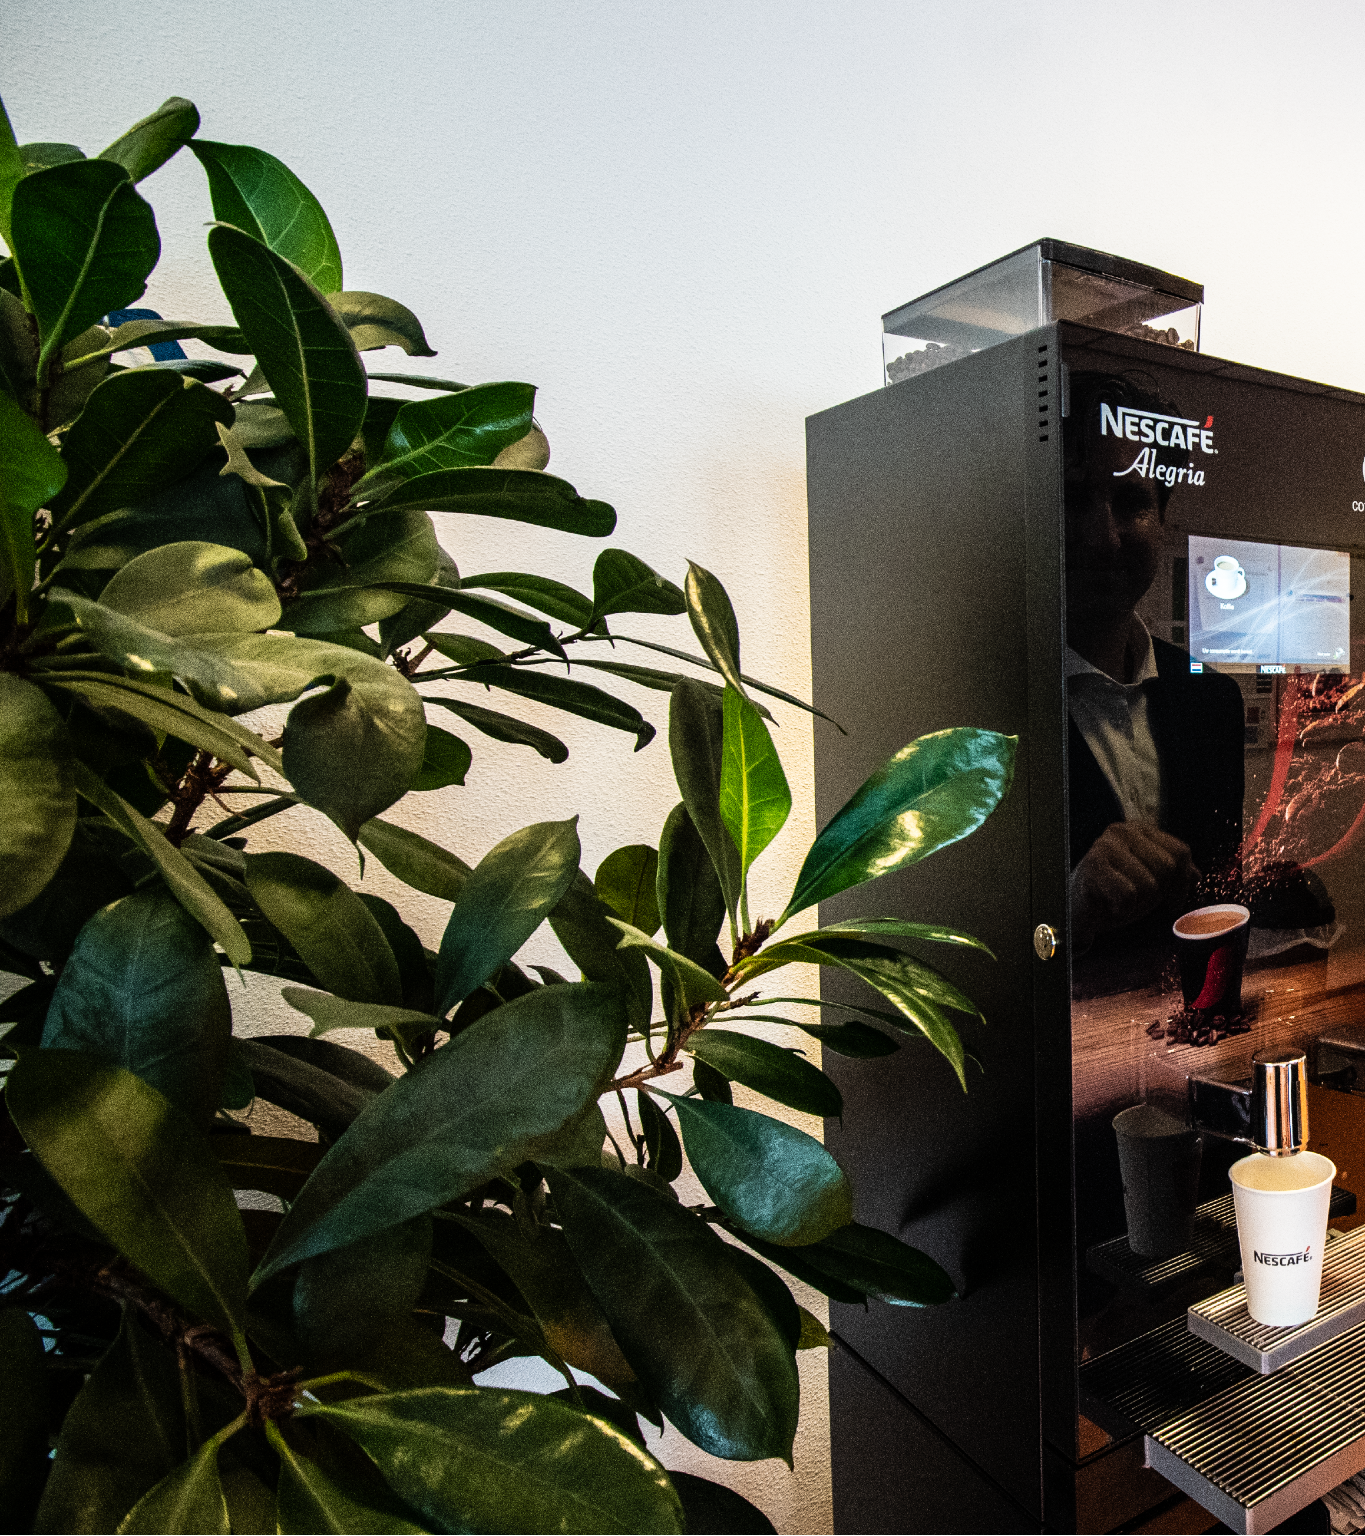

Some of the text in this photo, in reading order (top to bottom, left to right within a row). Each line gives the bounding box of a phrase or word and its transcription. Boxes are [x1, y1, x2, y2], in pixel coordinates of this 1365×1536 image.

[1100, 402, 1215, 454] NESCAFÉ
[1113, 447, 1206, 487] Alegria
[1253, 1245, 1311, 1267] NESCAFÉ
